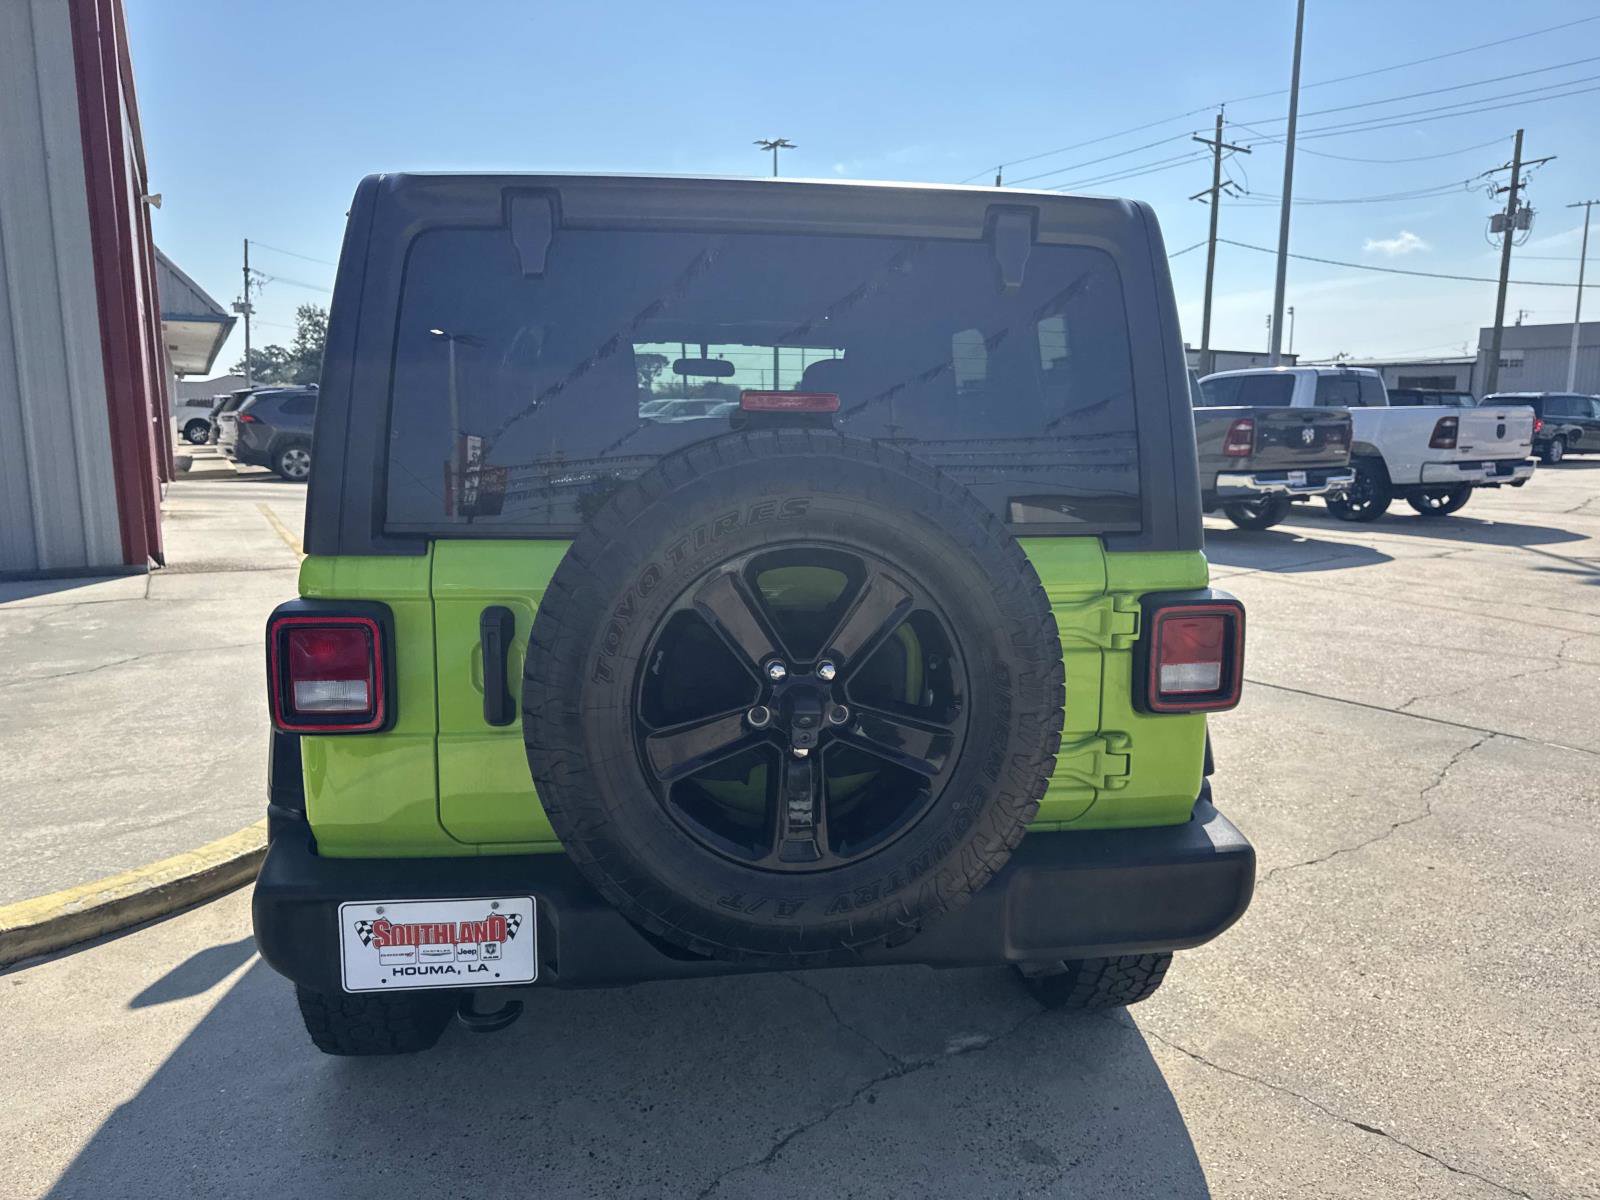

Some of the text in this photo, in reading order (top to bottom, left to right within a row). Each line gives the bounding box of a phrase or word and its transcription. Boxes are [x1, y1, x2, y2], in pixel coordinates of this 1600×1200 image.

[592, 565, 664, 686] TOYO
[661, 496, 811, 564] TIRES
[826, 786, 989, 916] COUNTRY
[715, 890, 806, 918] A/T
[372, 915, 508, 949] SOUTHLAND
[392, 963, 489, 976] HOUMA, LA
